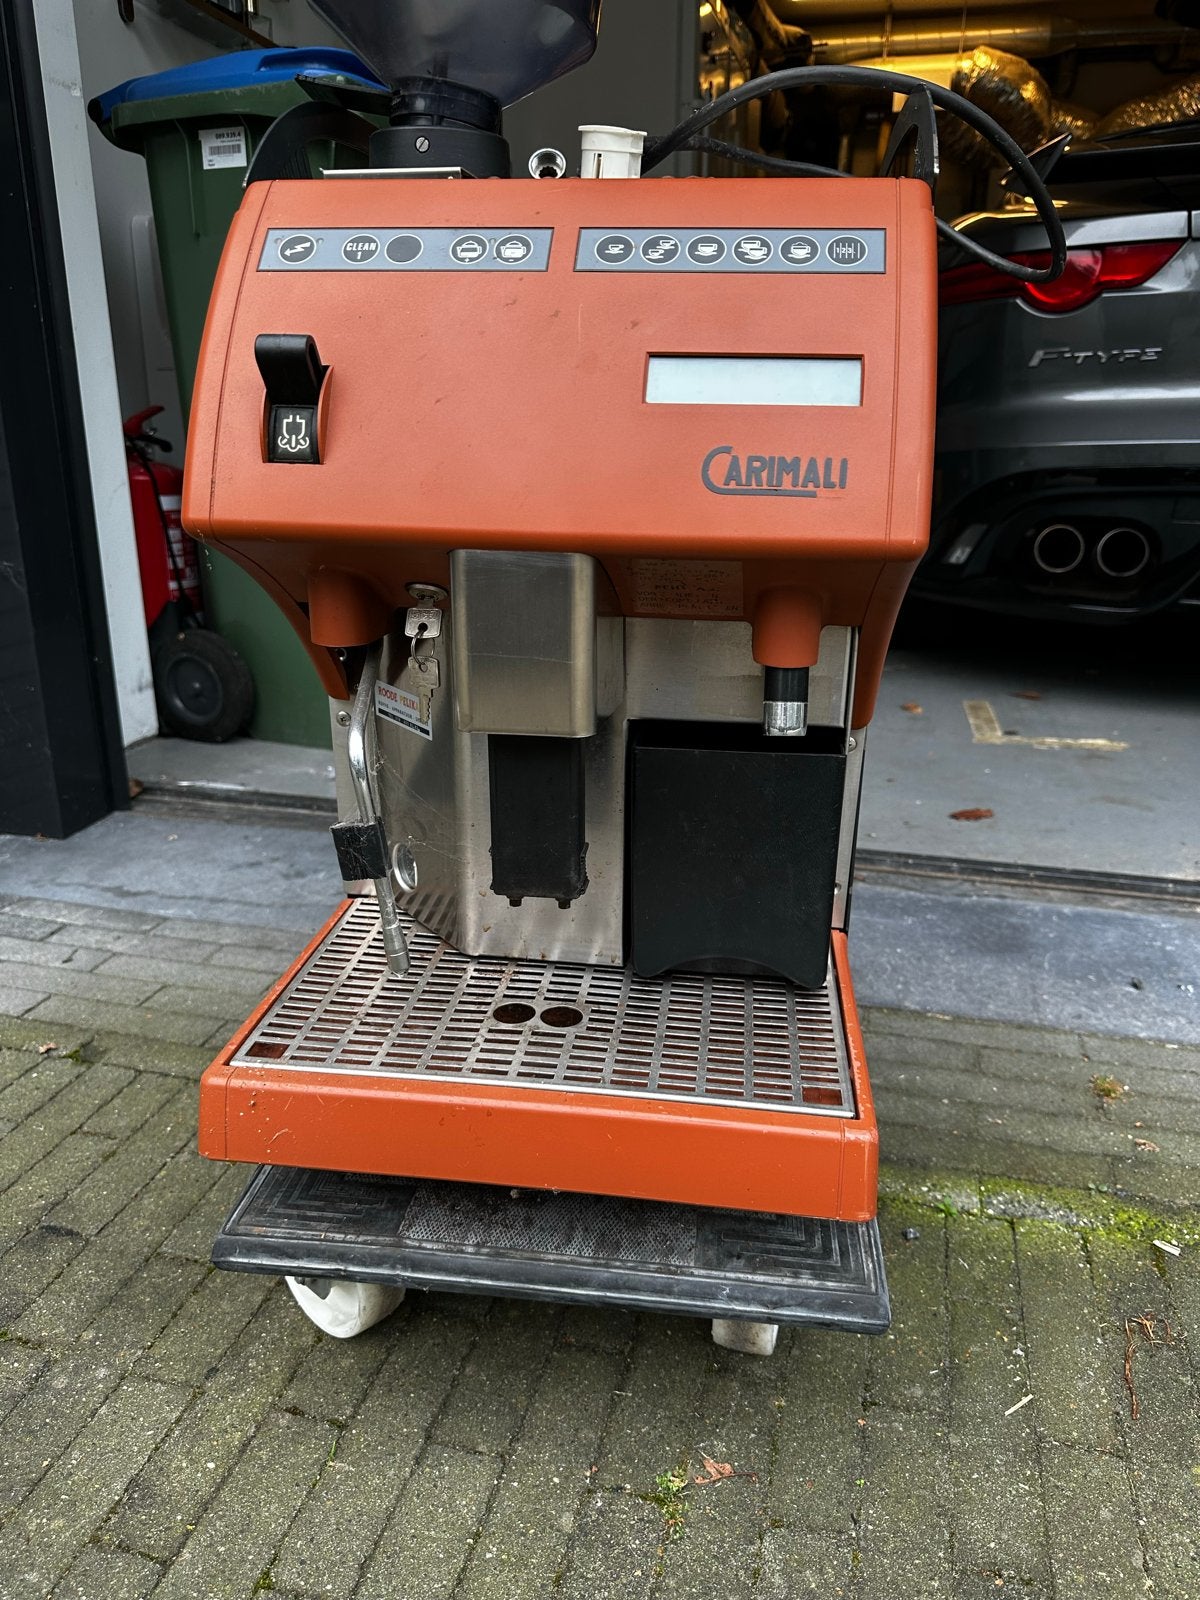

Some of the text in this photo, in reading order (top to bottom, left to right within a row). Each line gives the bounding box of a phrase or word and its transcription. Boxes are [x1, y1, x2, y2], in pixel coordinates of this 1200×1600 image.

[346, 242, 377, 251] CLEAN
[356, 251, 362, 260] 1
[1028, 347, 1162, 367] F-TYPE
[701, 446, 848, 498] CARIMALI
[378, 686, 398, 702] ROODE
